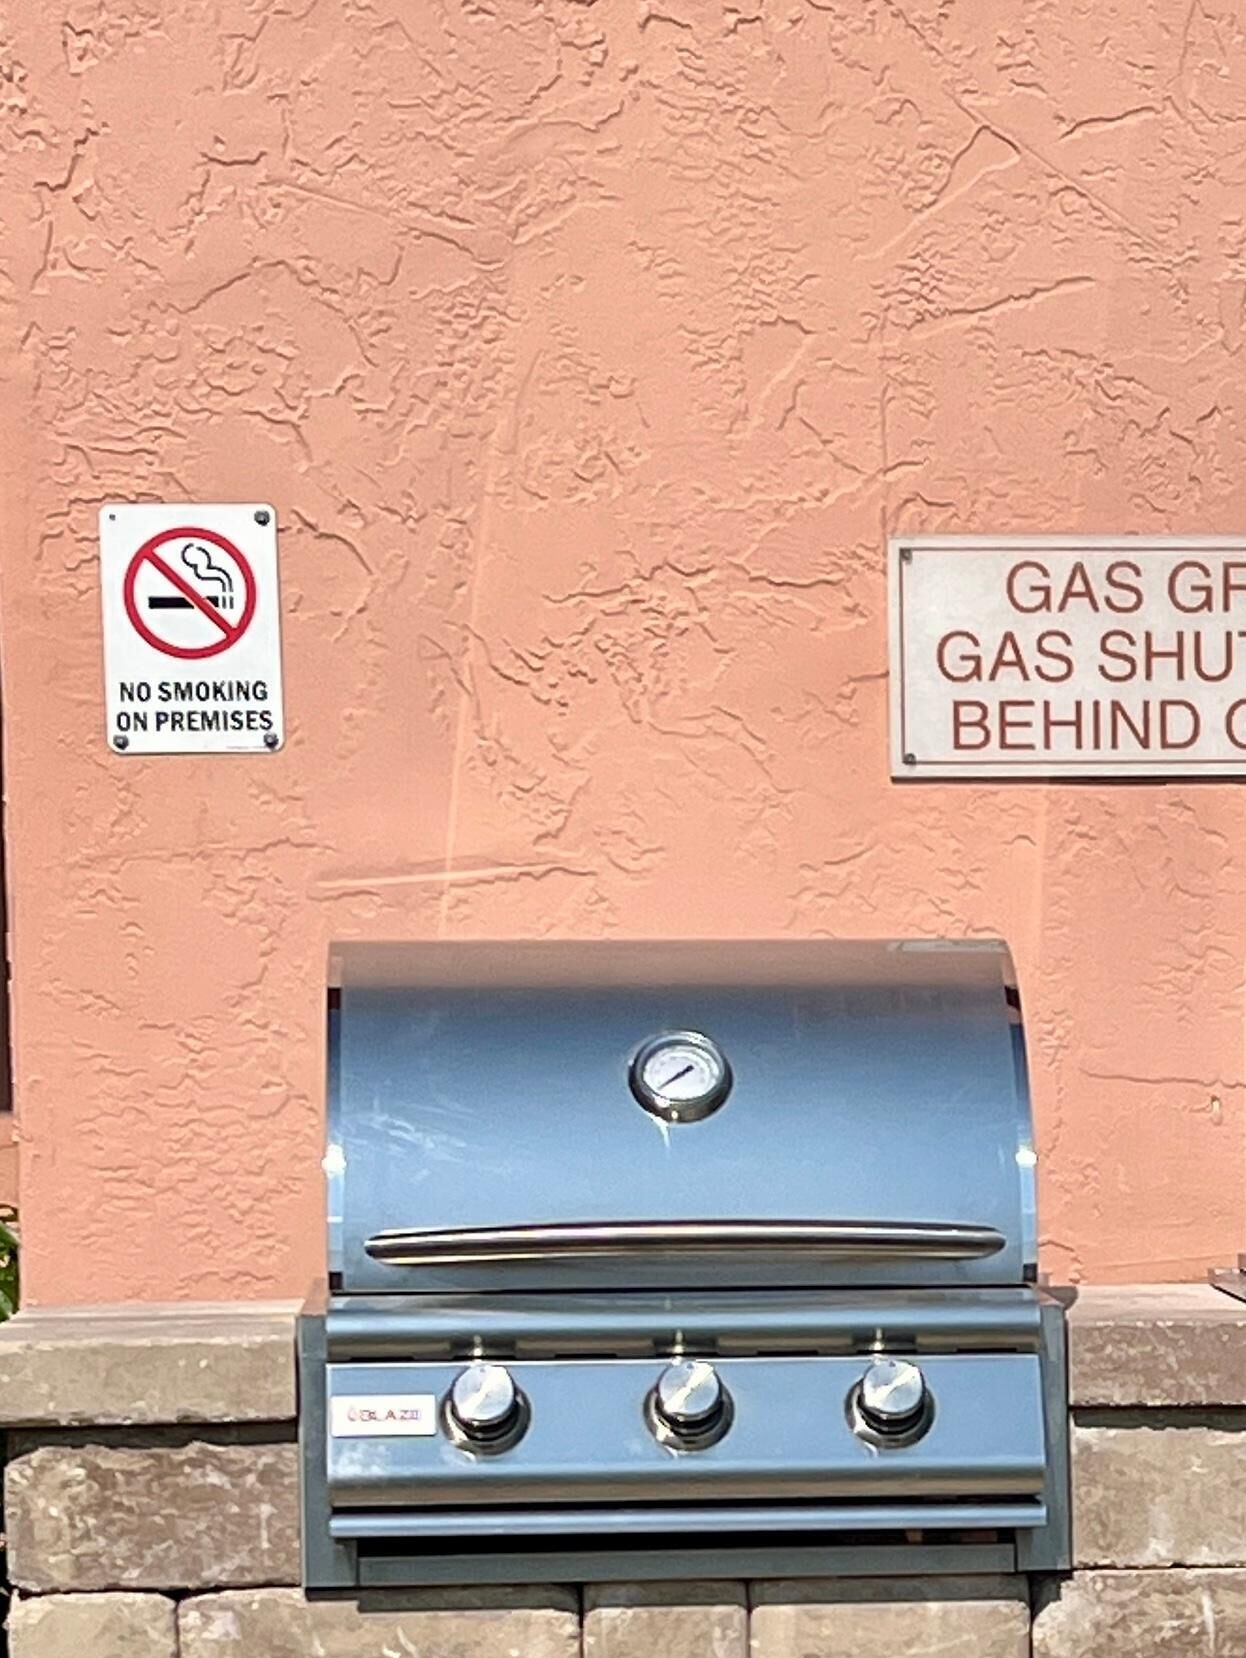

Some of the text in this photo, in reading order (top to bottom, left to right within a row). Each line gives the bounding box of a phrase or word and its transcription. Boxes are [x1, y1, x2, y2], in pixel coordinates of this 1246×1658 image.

[1006, 561, 1144, 614] GAS
[936, 631, 1074, 683] GAS
[119, 680, 268, 702] NO SMOKING
[116, 710, 274, 732] ON PREMISES
[952, 699, 1201, 751] BEHIND
